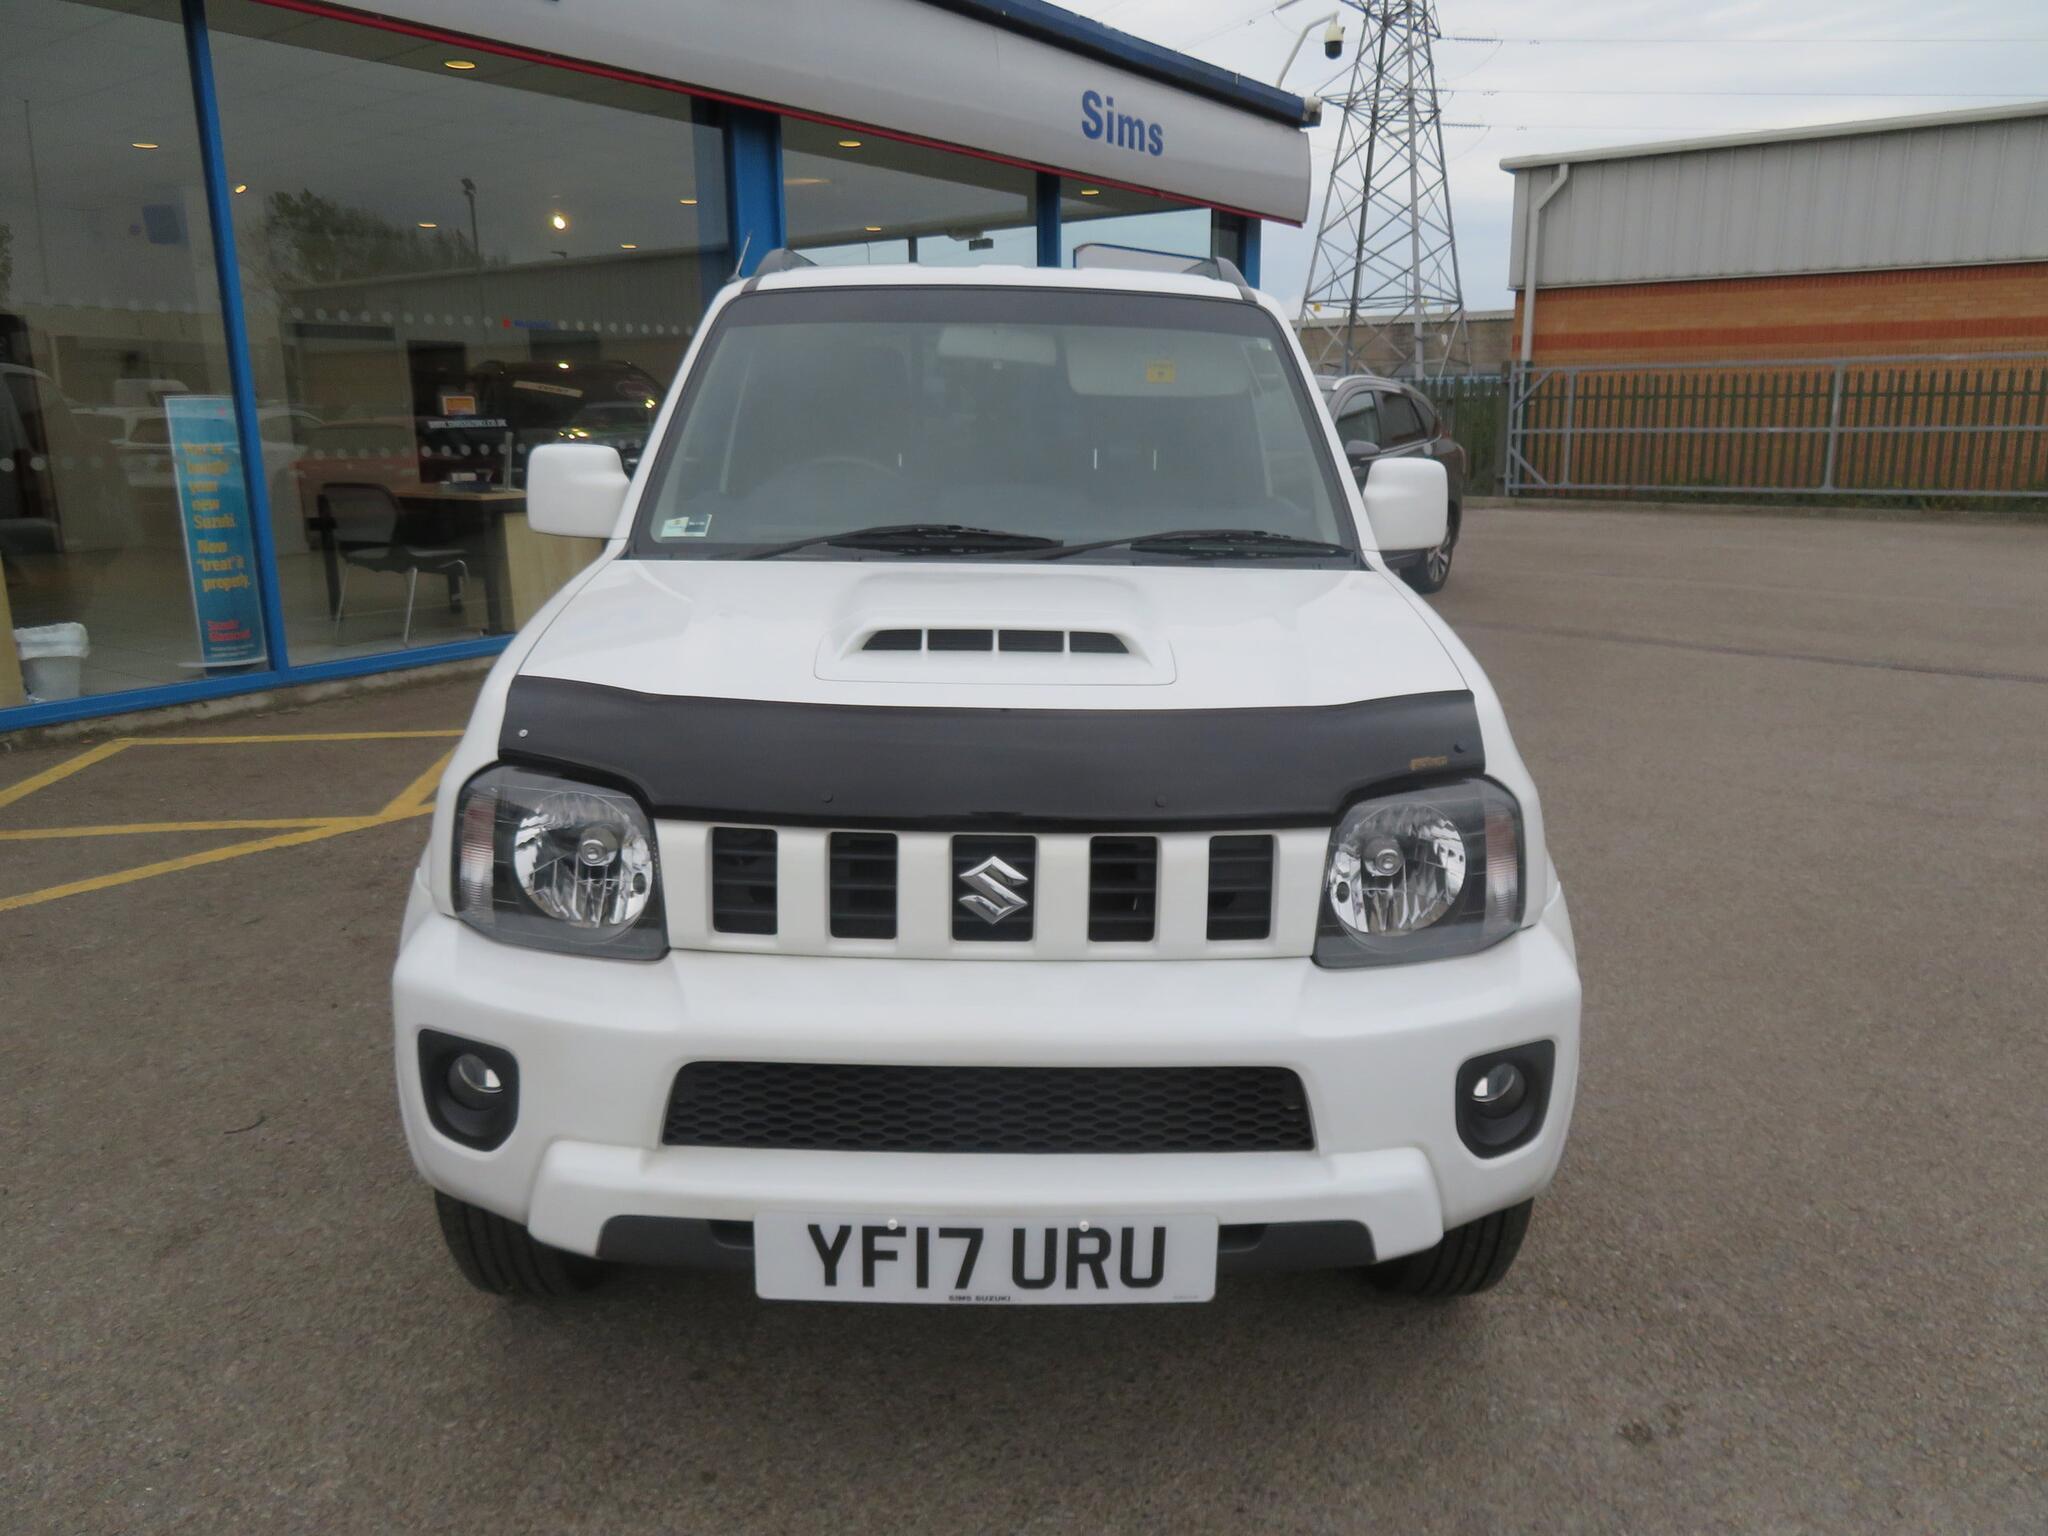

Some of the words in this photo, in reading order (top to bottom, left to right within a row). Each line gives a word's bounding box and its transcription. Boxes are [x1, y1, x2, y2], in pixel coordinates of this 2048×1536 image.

[1081, 90, 1164, 157] Sims
[807, 1223, 984, 1290] YF17
[1011, 1226, 1166, 1290] URU
